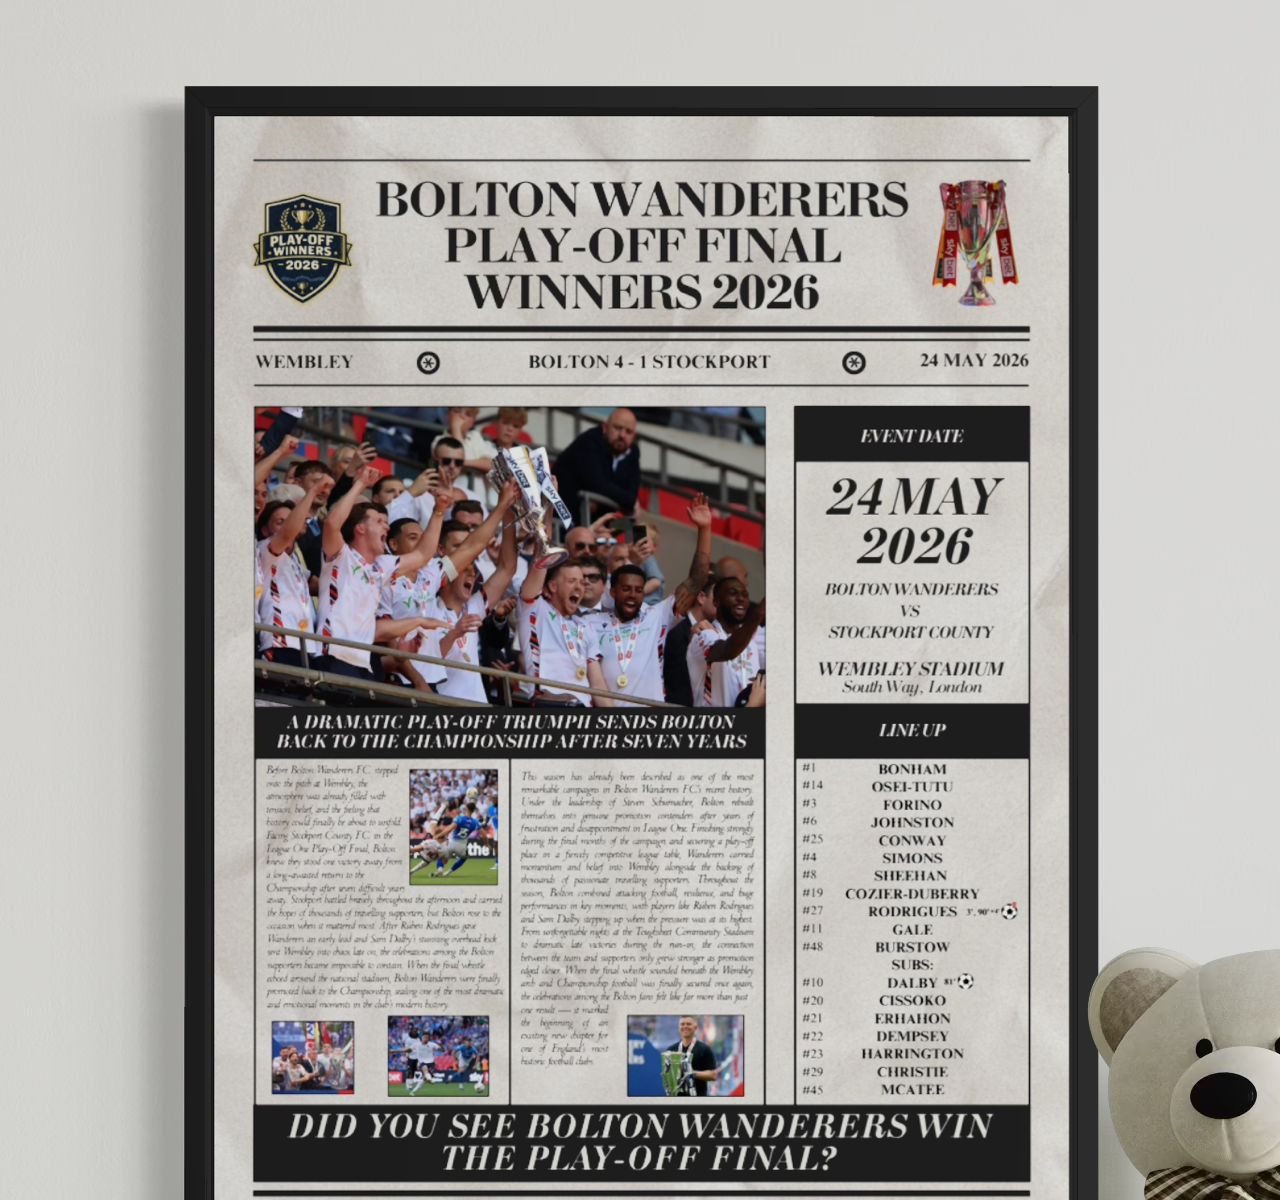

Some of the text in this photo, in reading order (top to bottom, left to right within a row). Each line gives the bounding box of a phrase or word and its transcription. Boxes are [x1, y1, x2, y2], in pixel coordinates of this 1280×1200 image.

[376, 181, 909, 218] BOLTON WANDERERS
[270, 234, 334, 247] PLAY-OFF
[444, 227, 842, 263] PLAY-OFF FINAL
[1000, 238, 1009, 255] sky
[273, 246, 332, 256] WINNERS
[945, 239, 955, 276] sky bet
[285, 260, 320, 270] 2026
[1002, 258, 1013, 275] bet
[463, 273, 819, 310] WINNERS 2026
[256, 355, 353, 368] WEMBLEY
[529, 355, 609, 369] BOLTON
[614, 355, 623, 368] 4
[641, 355, 646, 368] 1
[653, 355, 771, 369] STOCKPORT
[921, 353, 1029, 367] 24 MAY 2026
[861, 429, 964, 443] EVENT DATE
[545, 486, 570, 519] sky bet
[825, 477, 1005, 515] 24 MAY
[856, 527, 974, 565] 2026
[825, 583, 999, 596] BOLTON WANDERERS
[901, 605, 920, 617] VS
[828, 626, 994, 639] STOCKPORT COUNTY
[819, 662, 1005, 676] WEMBLEY STADIUM
[842, 680, 982, 697] South Way, London
[287, 715, 736, 729] A DRAMATIC PLAY-OFF TRIUMPH SENDS BOLTON
[879, 723, 947, 737] LINE UP
[277, 734, 747, 748] BACK TO THE CHAMPIONSHIP AFTER SEVEN YEARS
[803, 763, 946, 775] #1 BONHAM
[803, 780, 953, 792] #14 OSEI-TUTU
[803, 798, 942, 810] #3 FORINO
[803, 817, 954, 828] #6 JOHNSTON
[803, 834, 946, 846] #25 CONWAY
[467, 842, 490, 856] the
[803, 853, 943, 864] #4 SIMONS
[803, 870, 947, 881] #8 SHEEHAN
[803, 888, 980, 899] #19 COZIER-DUBERRY
[803, 905, 823, 915] #27
[869, 906, 957, 917] RODRIGUES
[803, 924, 933, 935] #11 GALE
[803, 942, 950, 953] #48 BURSTOW
[892, 959, 933, 970] SUBS:
[803, 978, 823, 987] #10
[888, 978, 938, 988] DALBY
[803, 995, 946, 1006] #20 CISSOKO
[803, 1013, 950, 1024] #21 ERHAHON
[803, 1031, 948, 1042] #22 DEMPSEY
[803, 1048, 964, 1059] #23 HARRINGTON
[803, 1066, 948, 1077] #29 CHRISTIE
[803, 1084, 945, 1095] #45 MCATEE
[287, 1113, 994, 1138] DID YOU SEE BOLTON WANDERERS WIN
[443, 1145, 837, 1171] THE PLAY-OFF FINAL?
